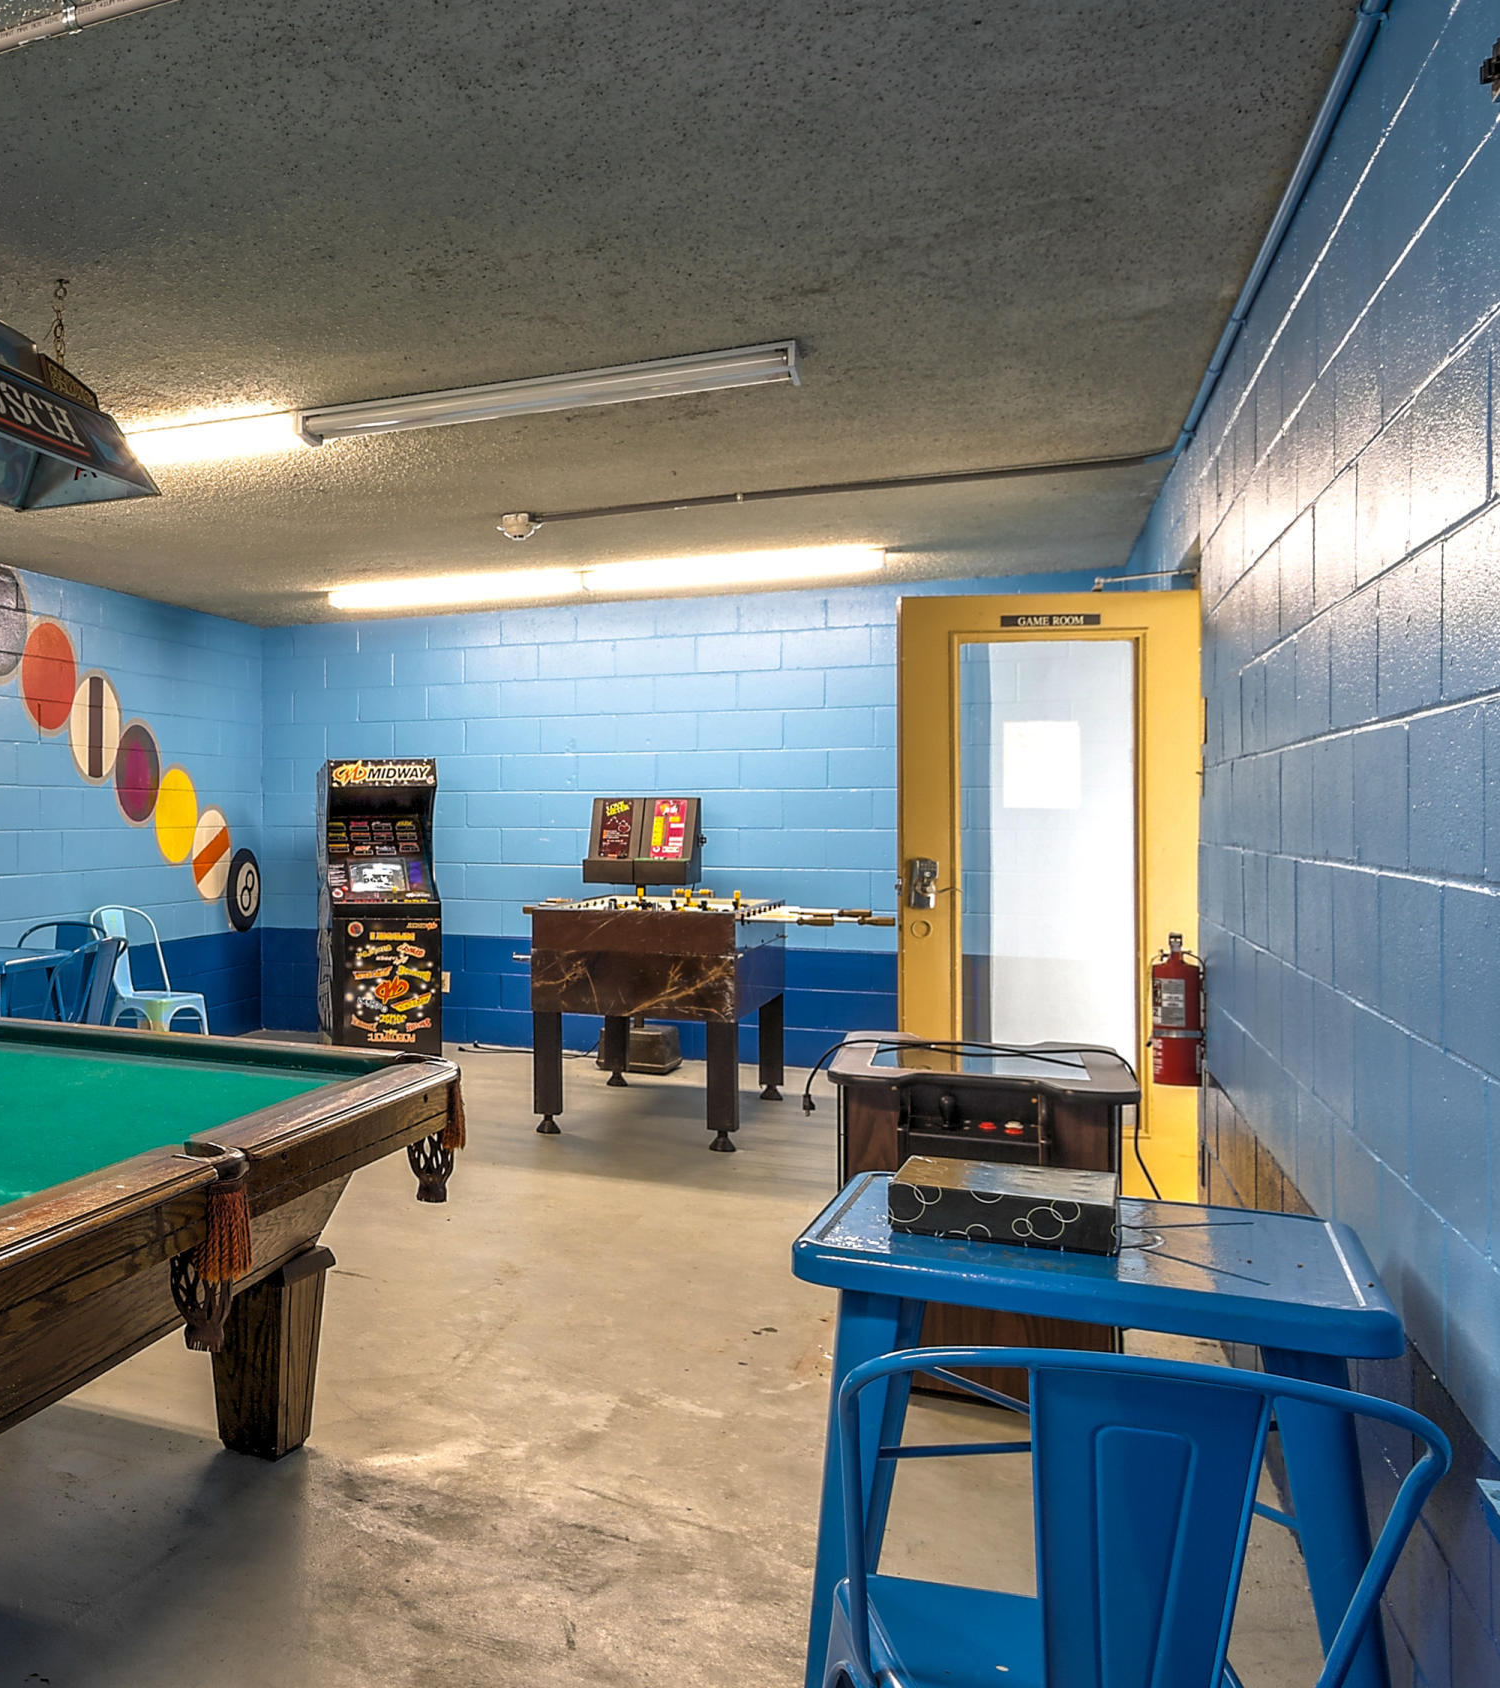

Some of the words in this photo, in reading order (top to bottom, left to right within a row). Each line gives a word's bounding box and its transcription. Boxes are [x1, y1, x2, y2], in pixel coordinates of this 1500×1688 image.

[1017, 616, 1050, 626] GAME
[1052, 615, 1085, 625] ROOM
[367, 766, 428, 779] MIDWAY
[240, 869, 255, 911] 8
